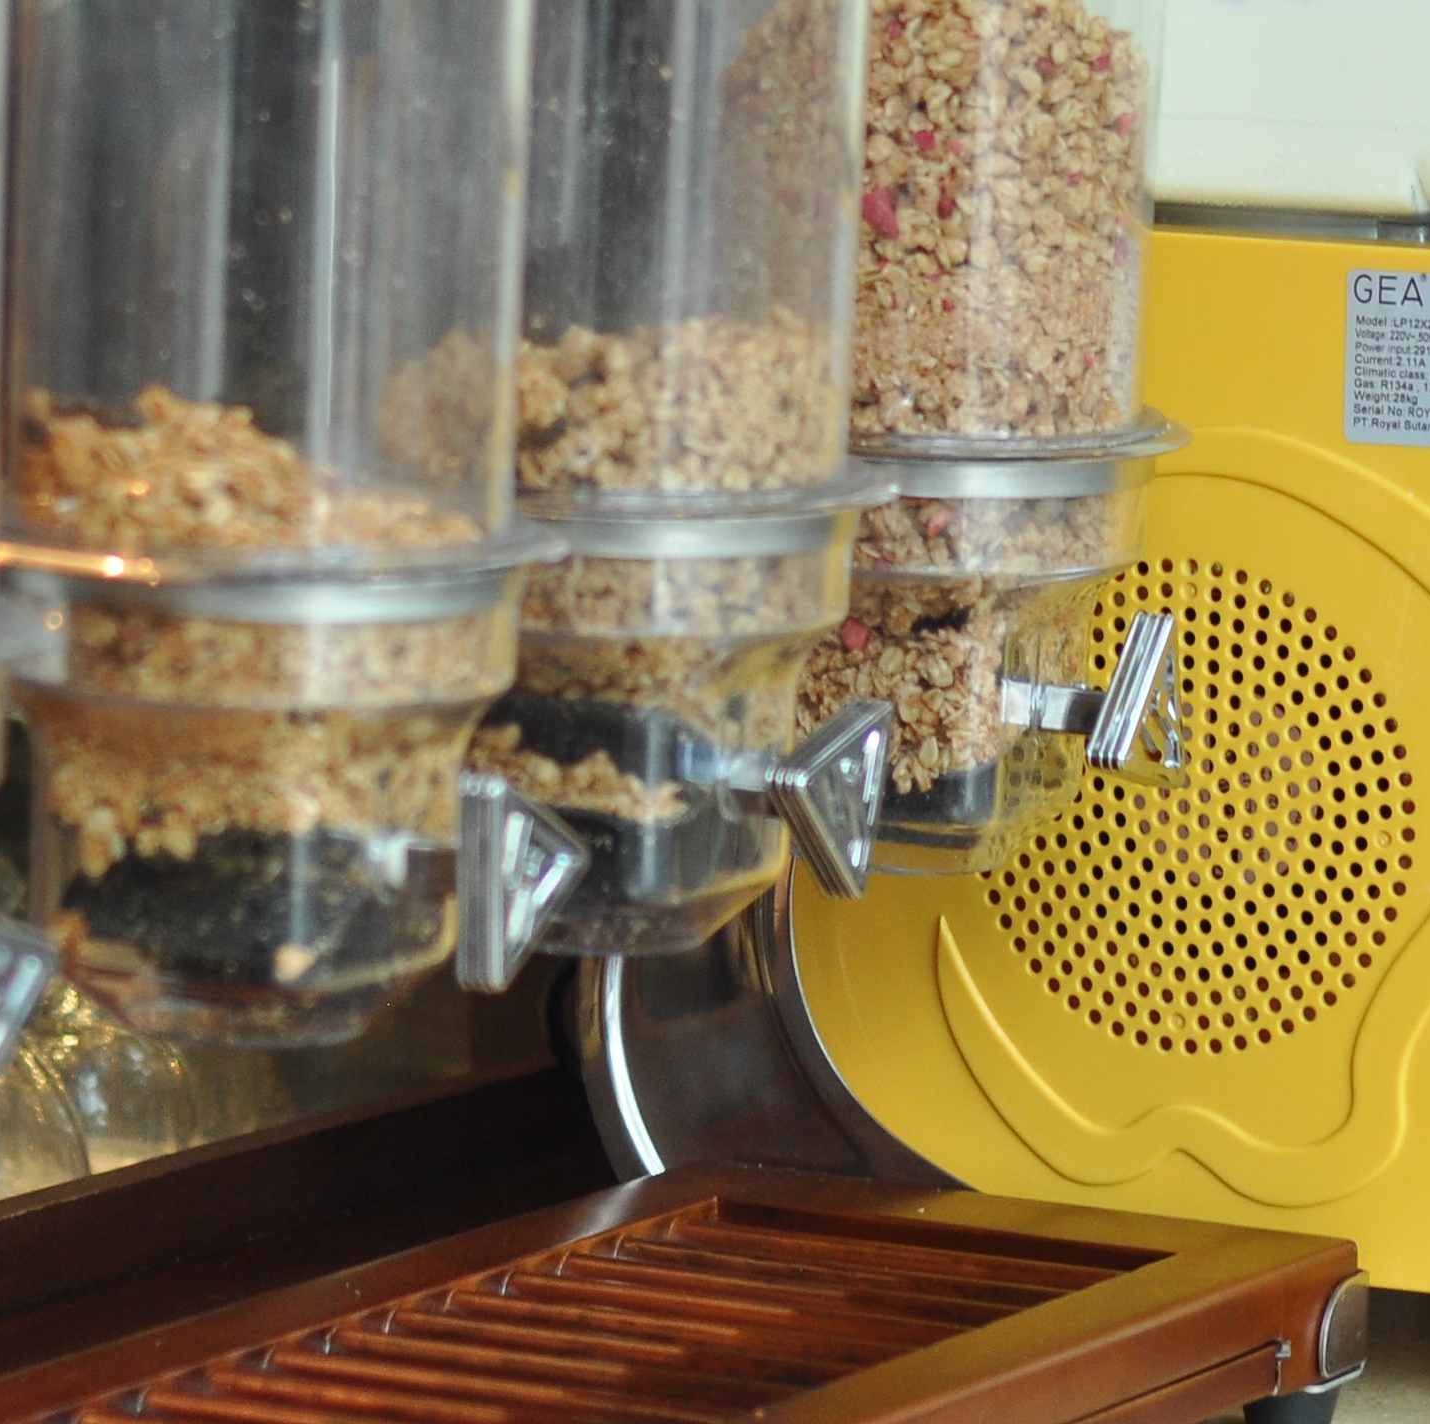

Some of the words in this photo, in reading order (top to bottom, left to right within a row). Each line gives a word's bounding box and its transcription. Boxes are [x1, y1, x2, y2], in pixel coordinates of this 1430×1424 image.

[1353, 274, 1424, 307] GEA
[1355, 314, 1387, 327] Model
[1355, 341, 1384, 353] Power
[1354, 366, 1396, 378] Climatic
[1353, 403, 1384, 416] Serial
